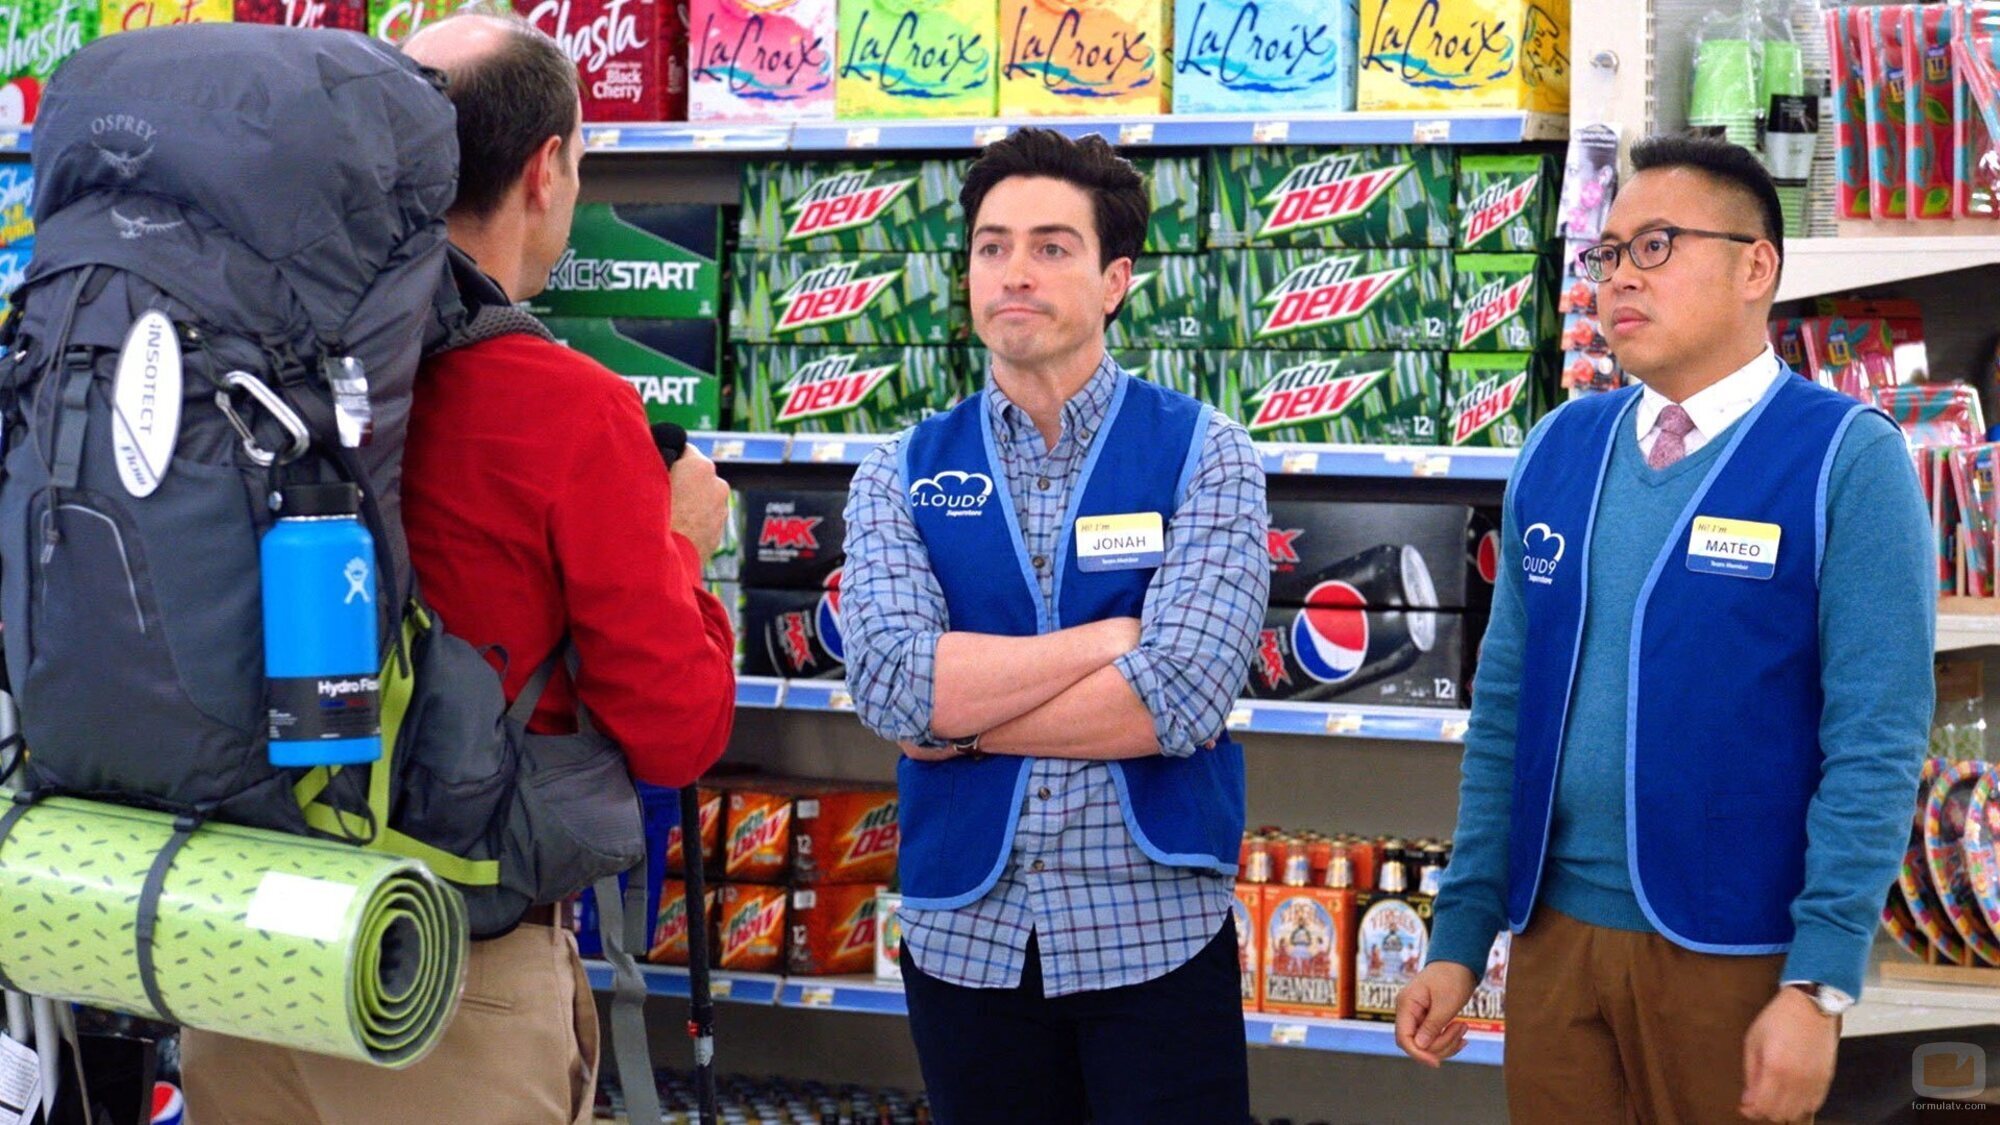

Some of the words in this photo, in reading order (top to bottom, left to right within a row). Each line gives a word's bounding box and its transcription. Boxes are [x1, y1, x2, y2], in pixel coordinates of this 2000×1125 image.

[0, 0, 81, 75] hasta
[616, 68, 642, 83] Black
[592, 81, 643, 103] Cherry
[91, 114, 157, 141] OSPREY
[1514, 227, 1529, 246] 12
[546, 248, 701, 291] KICKSTART
[1179, 317, 1196, 337] 12
[1424, 317, 1441, 337] 12
[1509, 327, 1525, 346] 12
[139, 323, 163, 435] INSOTECT
[1413, 416, 1429, 436] 12
[1501, 426, 1518, 445] 12
[910, 491, 988, 507] CLOUD9
[1093, 536, 1146, 551] JONAH
[1705, 539, 1761, 557] MATEO
[1522, 555, 1557, 576] OUD9
[318, 680, 359, 697] Hydro
[1434, 678, 1451, 699] 12
